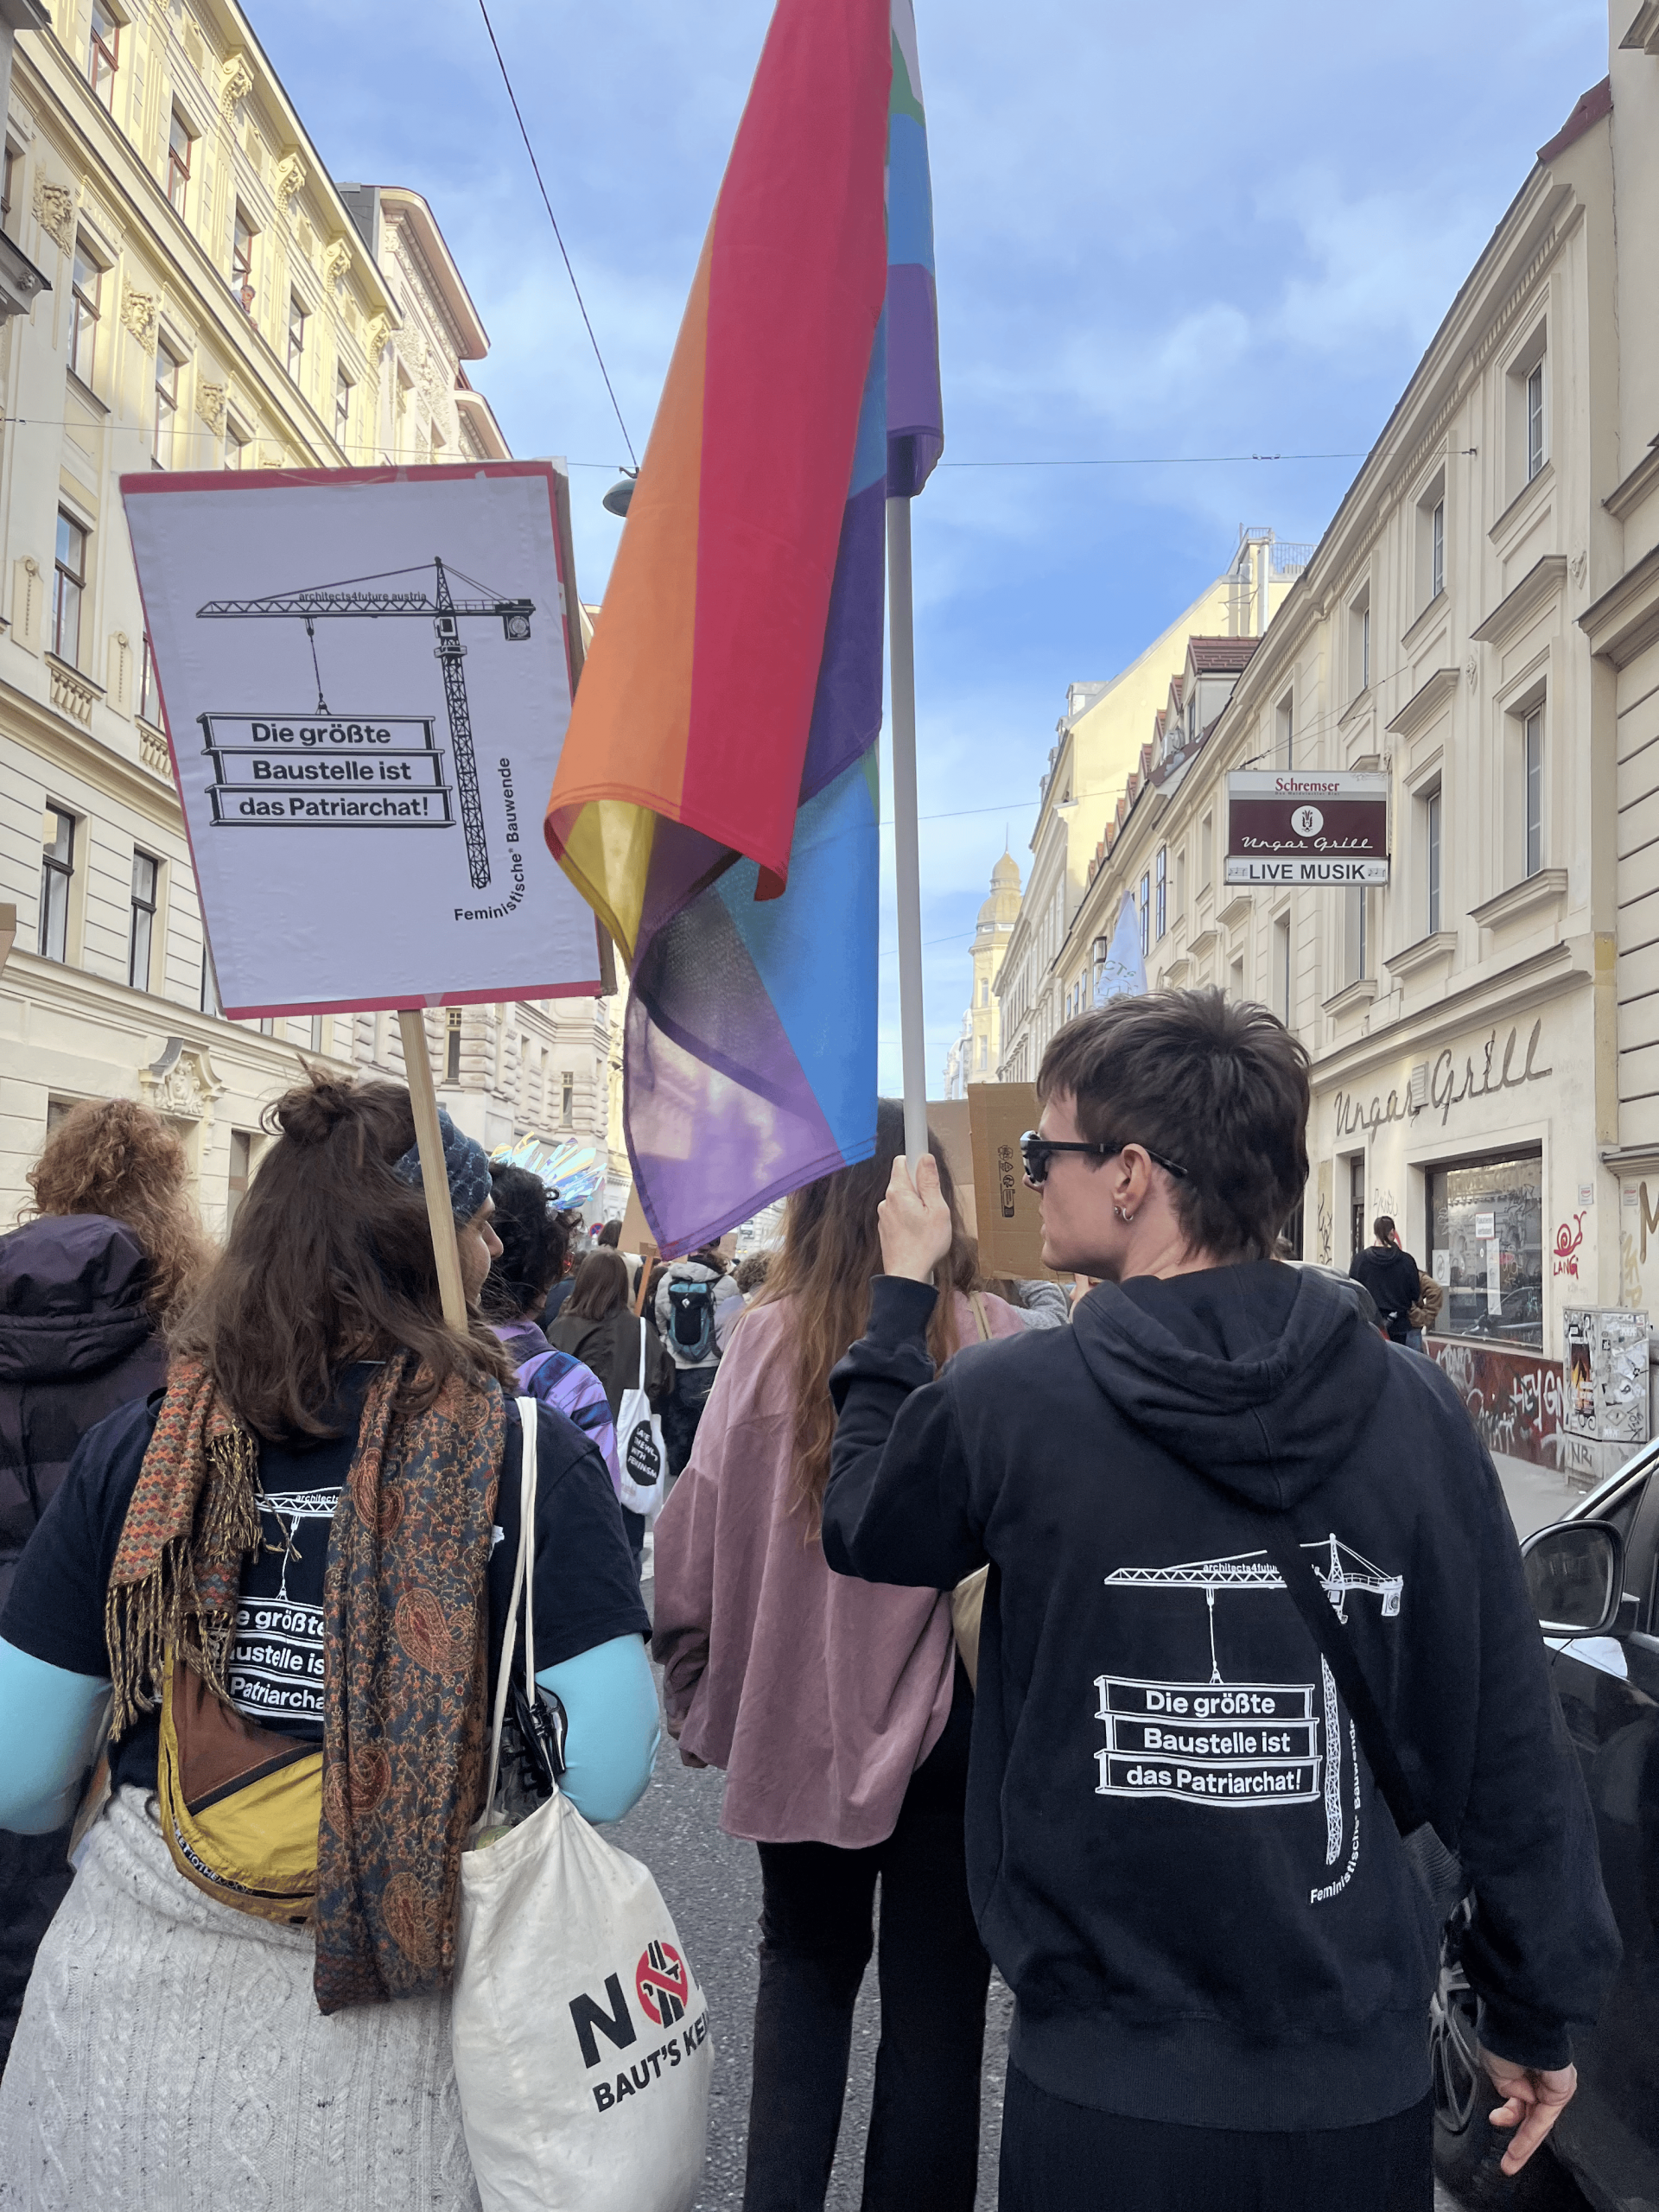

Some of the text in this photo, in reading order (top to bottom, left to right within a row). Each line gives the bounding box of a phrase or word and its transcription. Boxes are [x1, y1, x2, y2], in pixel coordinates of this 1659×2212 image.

[299, 591, 427, 601] architects4future austria
[251, 722, 391, 747] Die größte
[252, 760, 412, 780] Baustelle ist
[1274, 777, 1340, 792] Schremser
[239, 796, 429, 817] das Patriarchat!
[498, 757, 519, 842] Bauwende
[1241, 836, 1373, 852] Ungar Grill
[1249, 864, 1366, 880] LIVE MUSIK
[1431, 1016, 1553, 1127] Grill
[1146, 1689, 1276, 1718] Die größte
[1143, 1728, 1291, 1754] Baustelle ist
[1126, 1765, 1302, 1794] das Patriarchat!
[592, 2038, 682, 2113] BAUT'S
